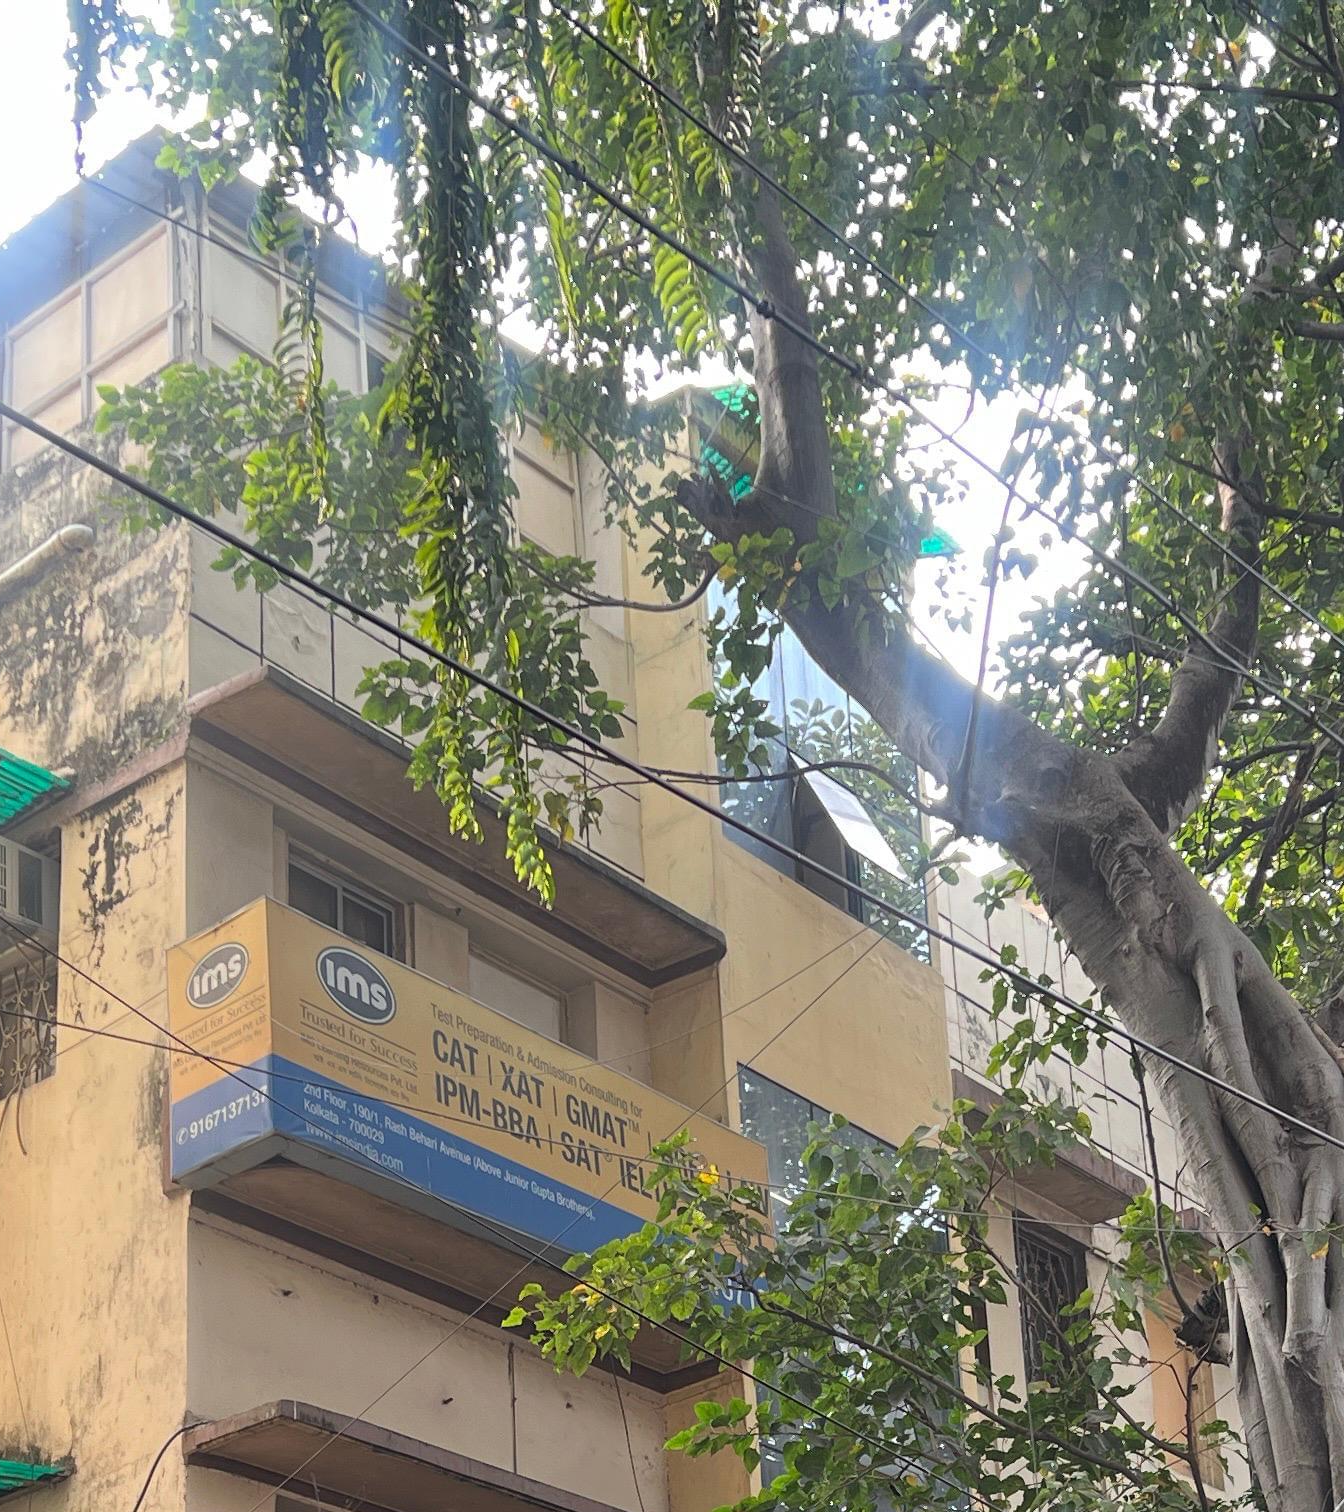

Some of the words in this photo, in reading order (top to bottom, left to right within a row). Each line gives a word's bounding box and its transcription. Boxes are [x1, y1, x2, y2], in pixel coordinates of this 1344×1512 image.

[299, 1004, 345, 1038] Trusted
[349, 1028, 367, 1049] for
[369, 1039, 418, 1073] Success
[430, 1002, 454, 1028] Test
[456, 1015, 514, 1057] Preparation
[516, 1046, 525, 1062] &
[528, 1051, 577, 1087] Admission
[579, 1077, 628, 1115] Consulting
[630, 1100, 643, 1118] for
[433, 1029, 479, 1077] CAT
[499, 1060, 545, 1109] XAT
[189, 1085, 268, 1139] 9167137137
[303, 1098, 340, 1125] Kolkata
[348, 1118, 385, 1145] 700029
[303, 1083, 322, 1100] 2nd
[384, 1116, 408, 1137] Rash
[409, 1127, 438, 1151] Behari
[439, 1141, 472, 1165] Avenue
[473, 1156, 502, 1180] (Above
[503, 1170, 529, 1192] Junior
[531, 1181, 556, 1204] Gupta
[435, 1071, 542, 1149] IPM-BBA
[305, 1122, 404, 1173] www.imsindia.com
